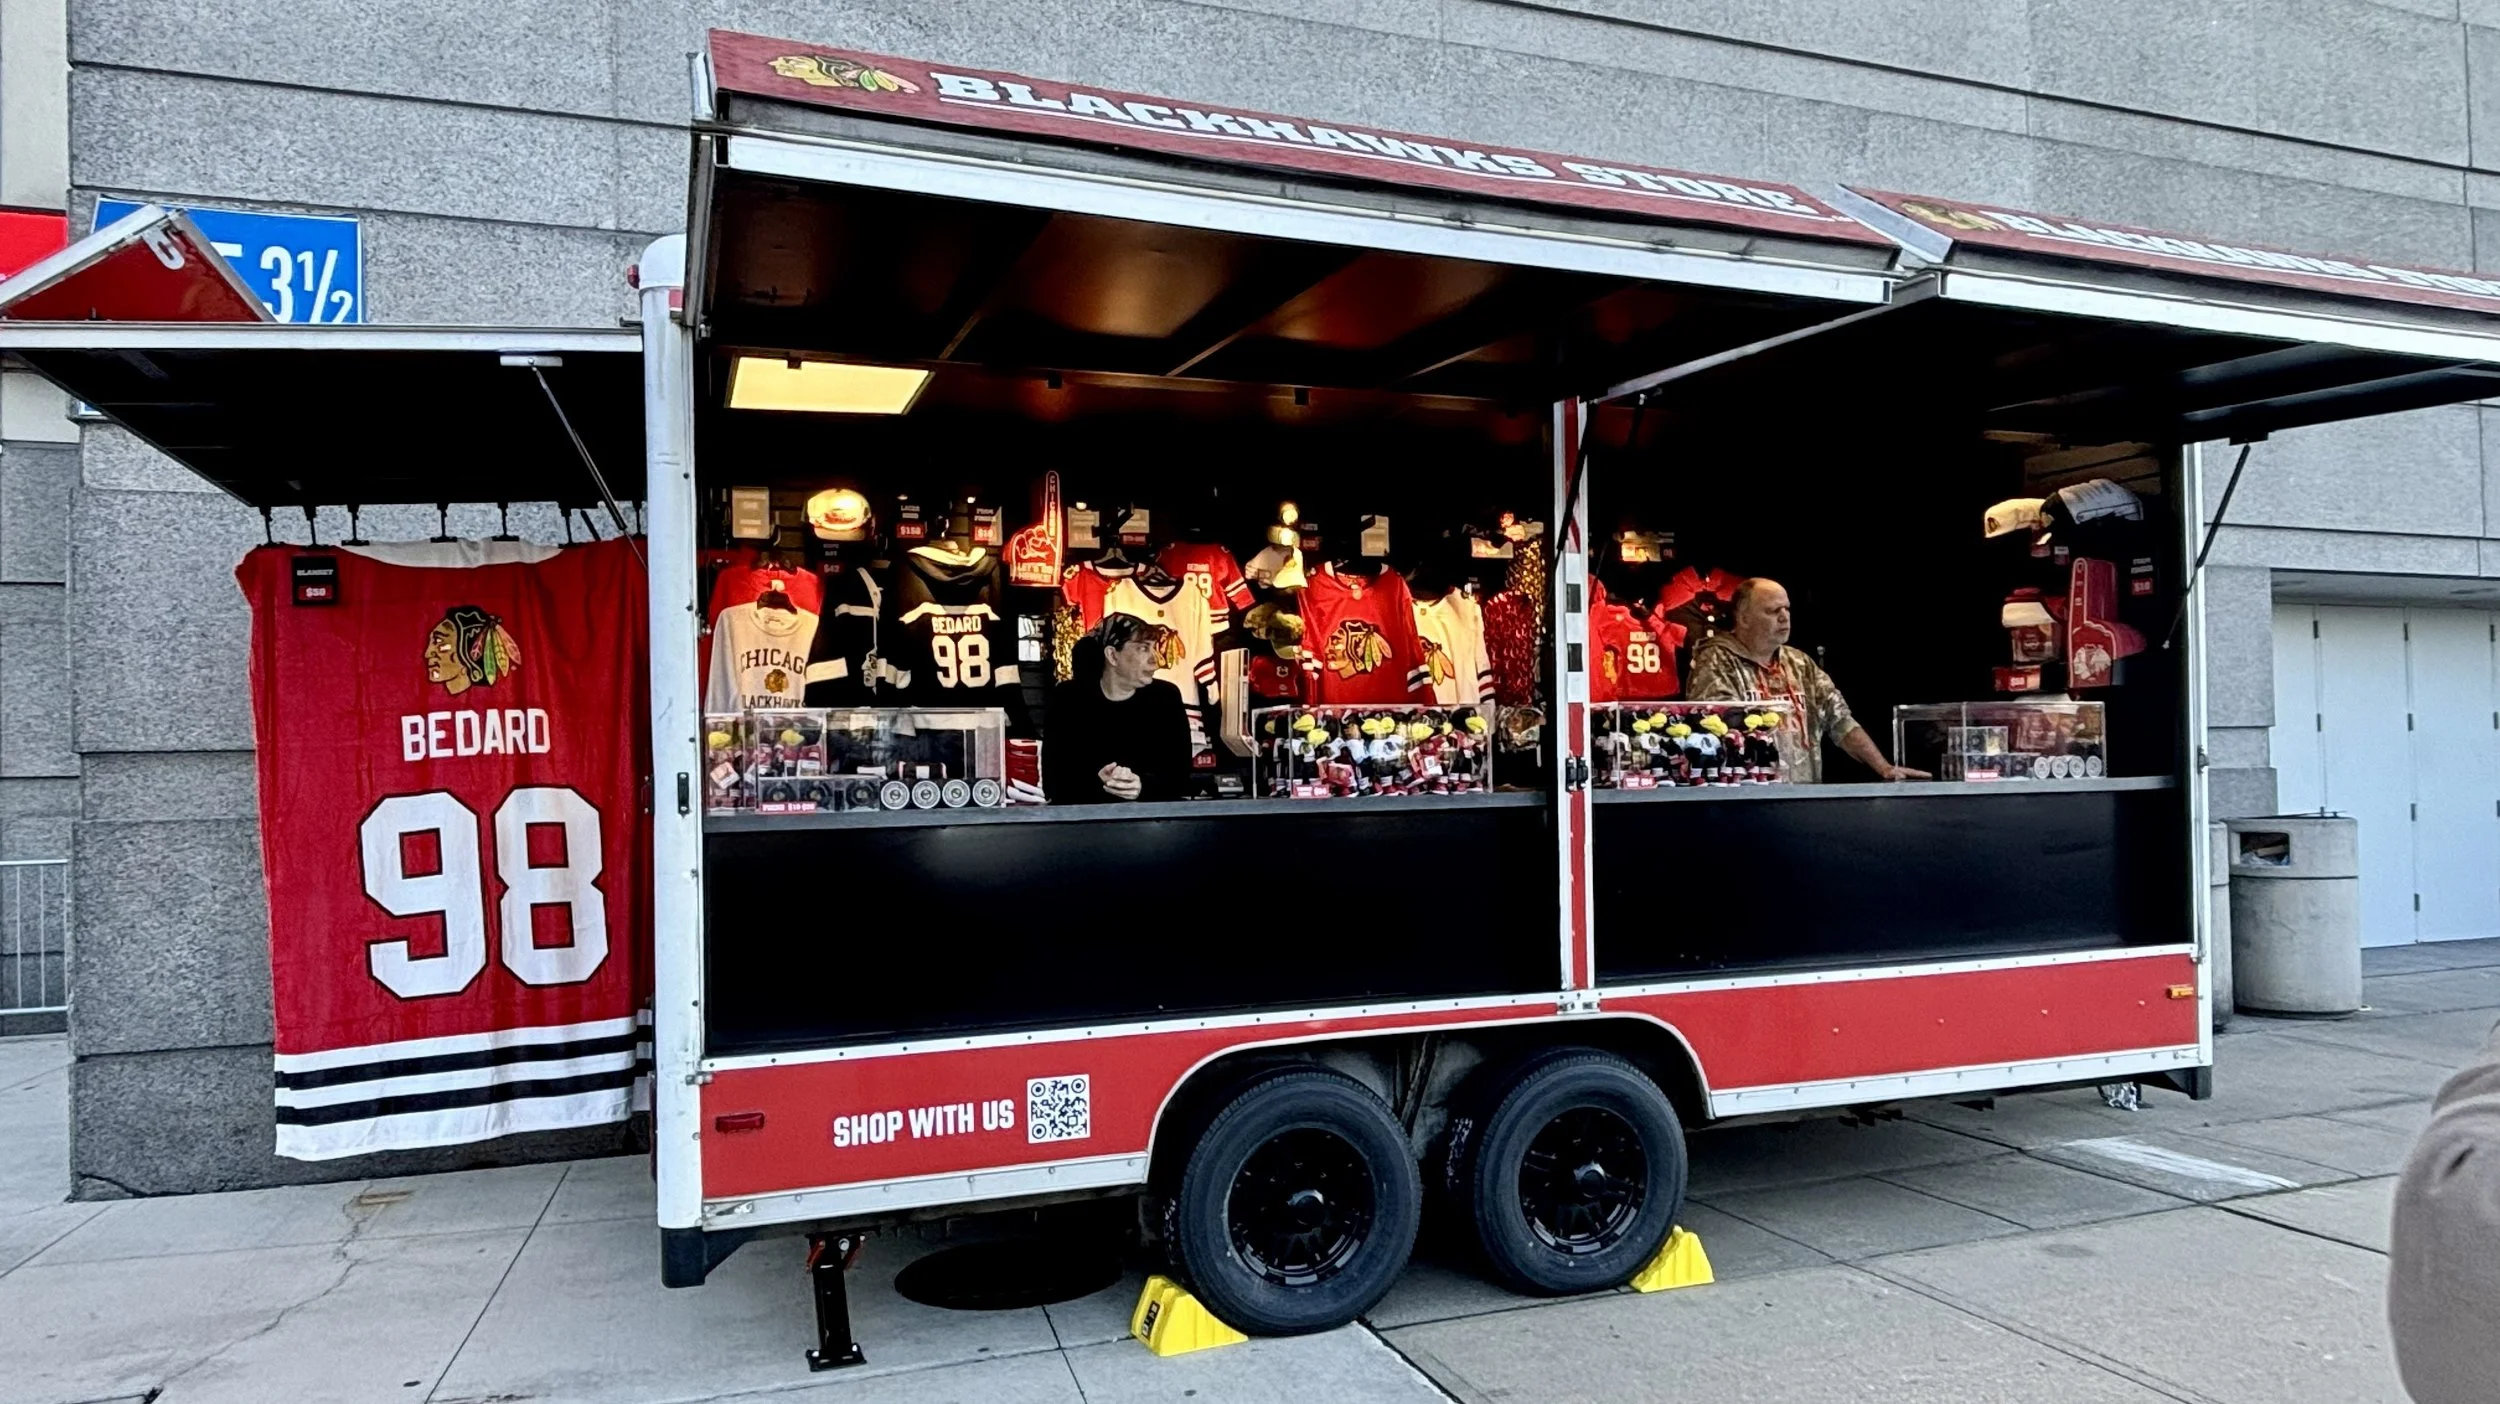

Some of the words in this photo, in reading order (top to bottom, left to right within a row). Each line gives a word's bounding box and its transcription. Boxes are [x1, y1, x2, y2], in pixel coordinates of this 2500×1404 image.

[930, 72, 1555, 178] BLACKHAWKS
[1562, 161, 1818, 213] STORE
[2367, 264, 2500, 296] STO
[932, 616, 981, 633] BEDARD
[741, 648, 806, 681] CHICAG
[932, 634, 990, 688] 98
[1627, 643, 1660, 673] 98
[401, 708, 550, 762] BEDARD
[360, 787, 608, 998] 98
[834, 1112, 903, 1147] SHOP
[908, 1103, 974, 1138] WITH
[982, 1099, 1015, 1130] US
